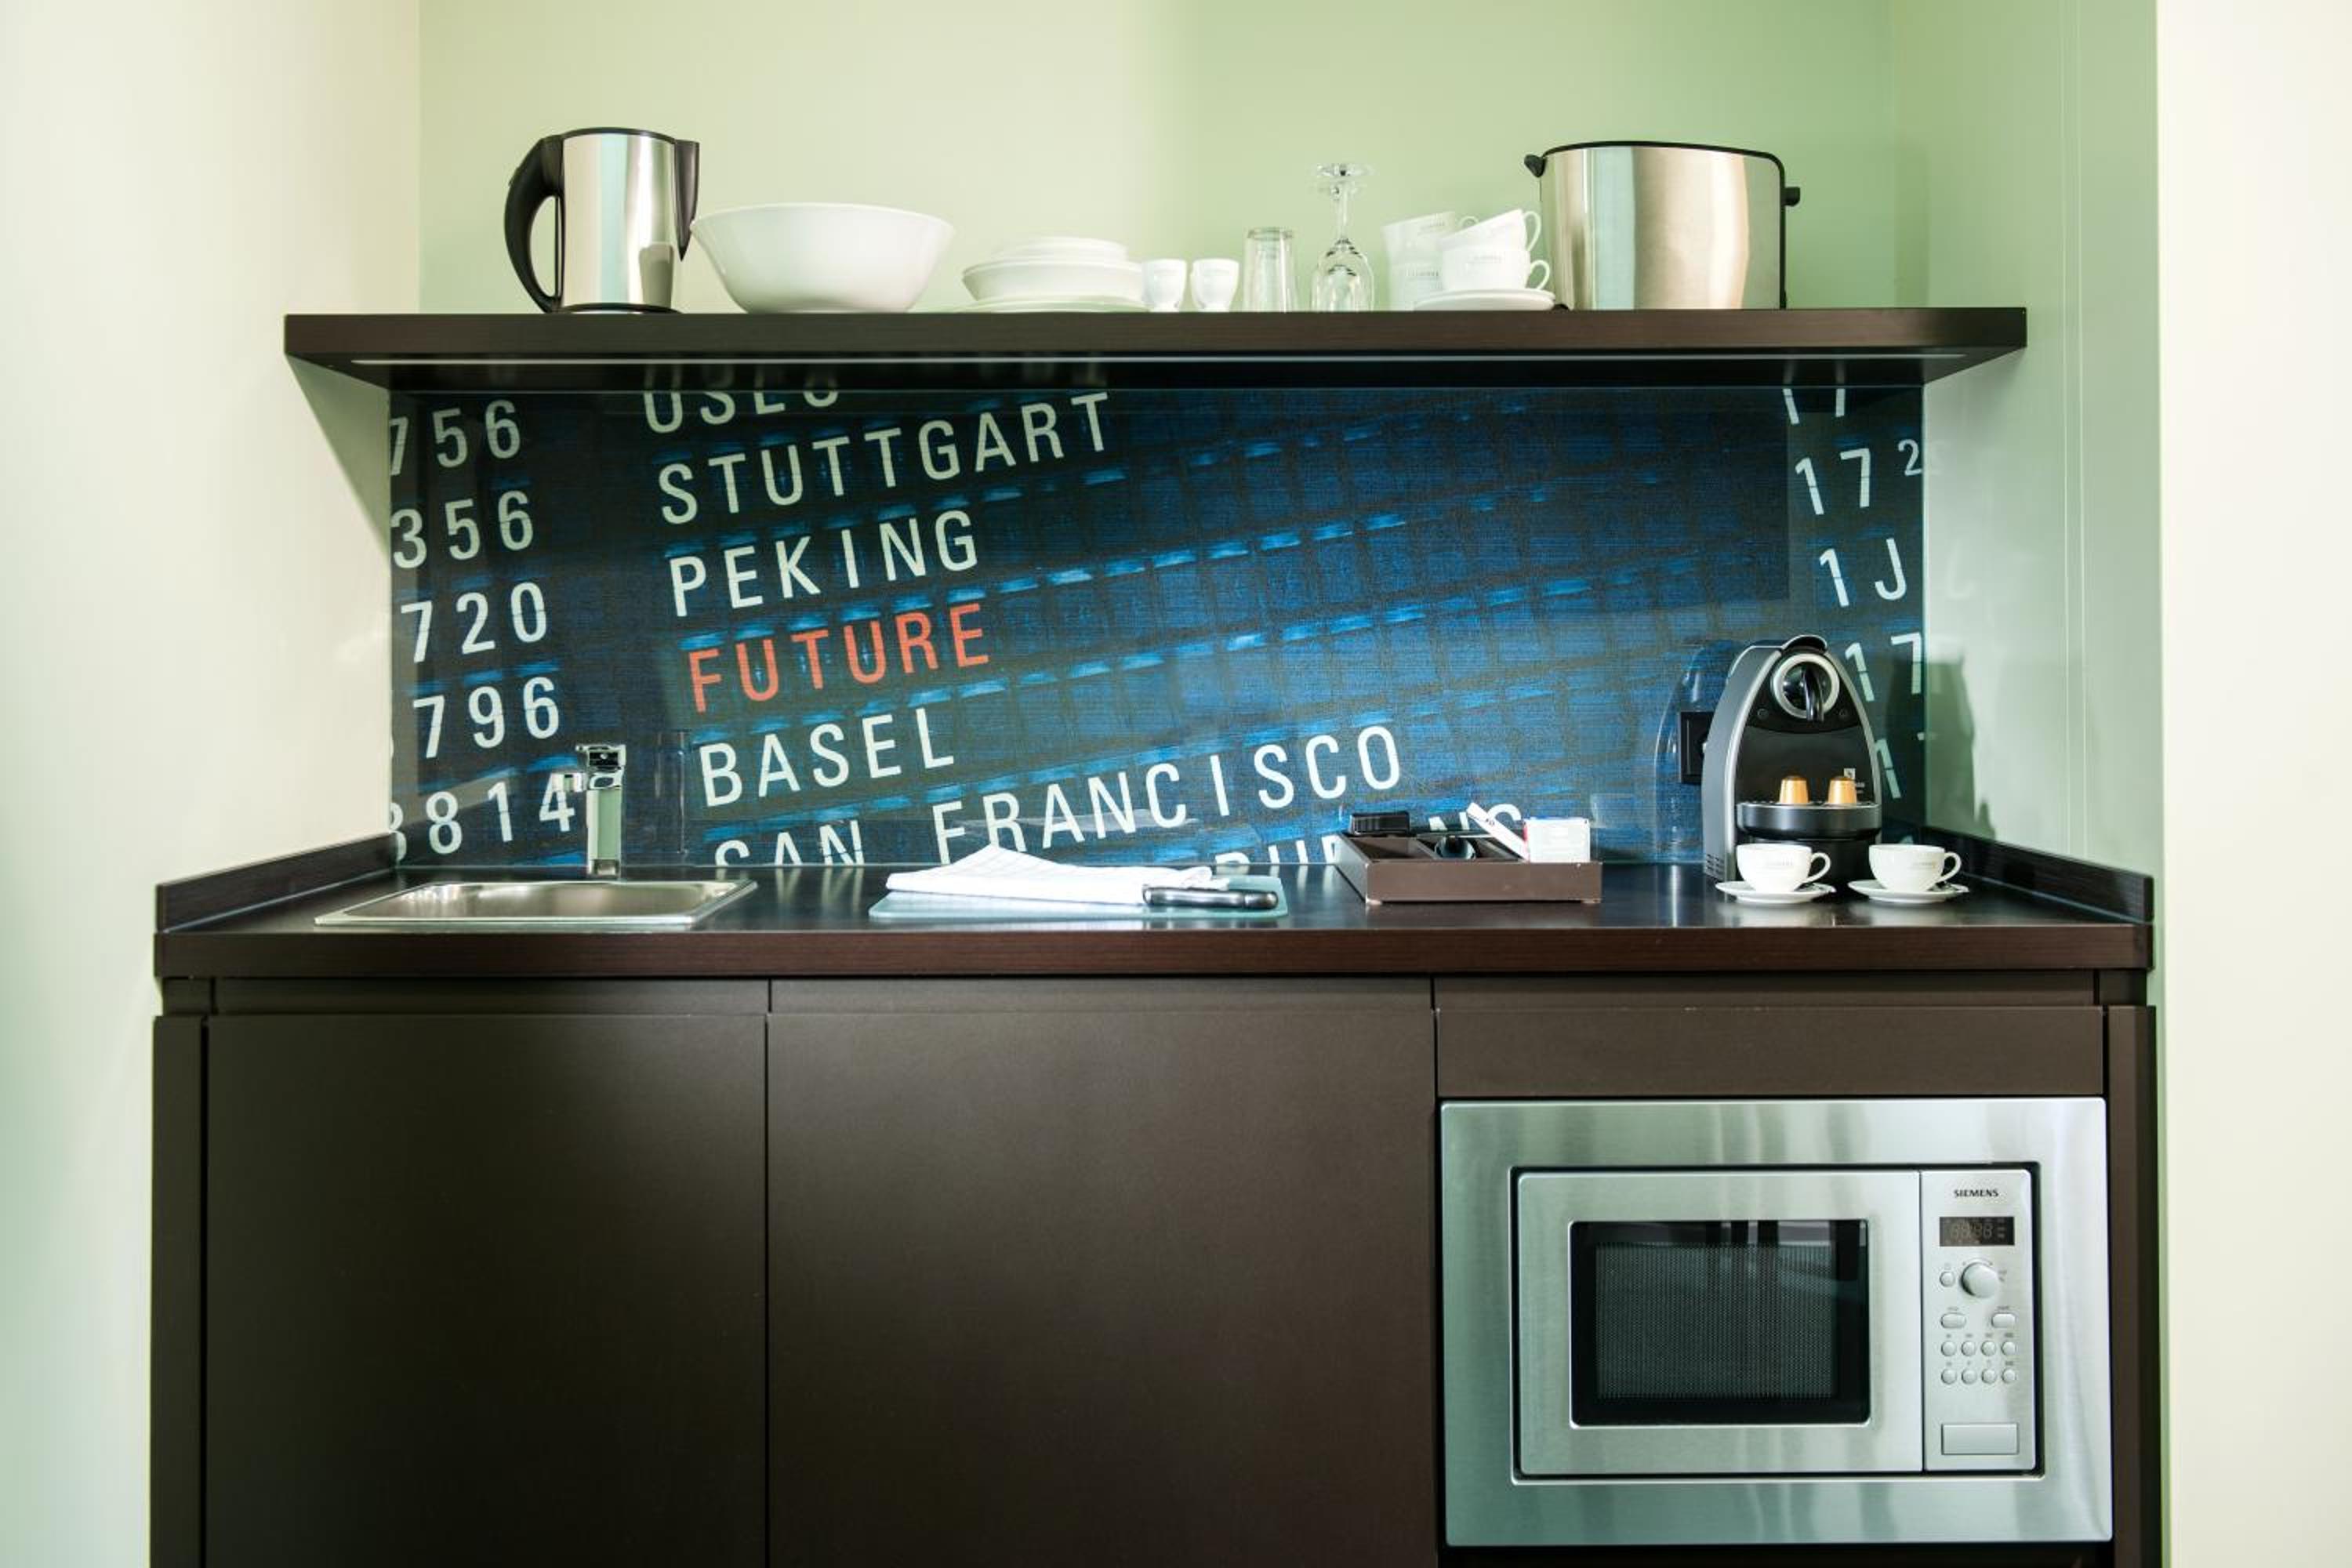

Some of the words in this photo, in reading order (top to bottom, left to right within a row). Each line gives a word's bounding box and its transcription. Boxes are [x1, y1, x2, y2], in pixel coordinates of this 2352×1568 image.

[390, 400, 521, 476] 756
[658, 393, 1108, 524] STUTTGART
[391, 490, 534, 568] 356
[670, 510, 978, 617] PEKING
[401, 582, 546, 662] 720
[688, 603, 989, 713] FUTURE
[412, 677, 559, 758] 796
[700, 707, 954, 808] BASEL
[931, 725, 1400, 864] FRANCISCO
[1954, 1189, 1999, 1198] SIEMENS
